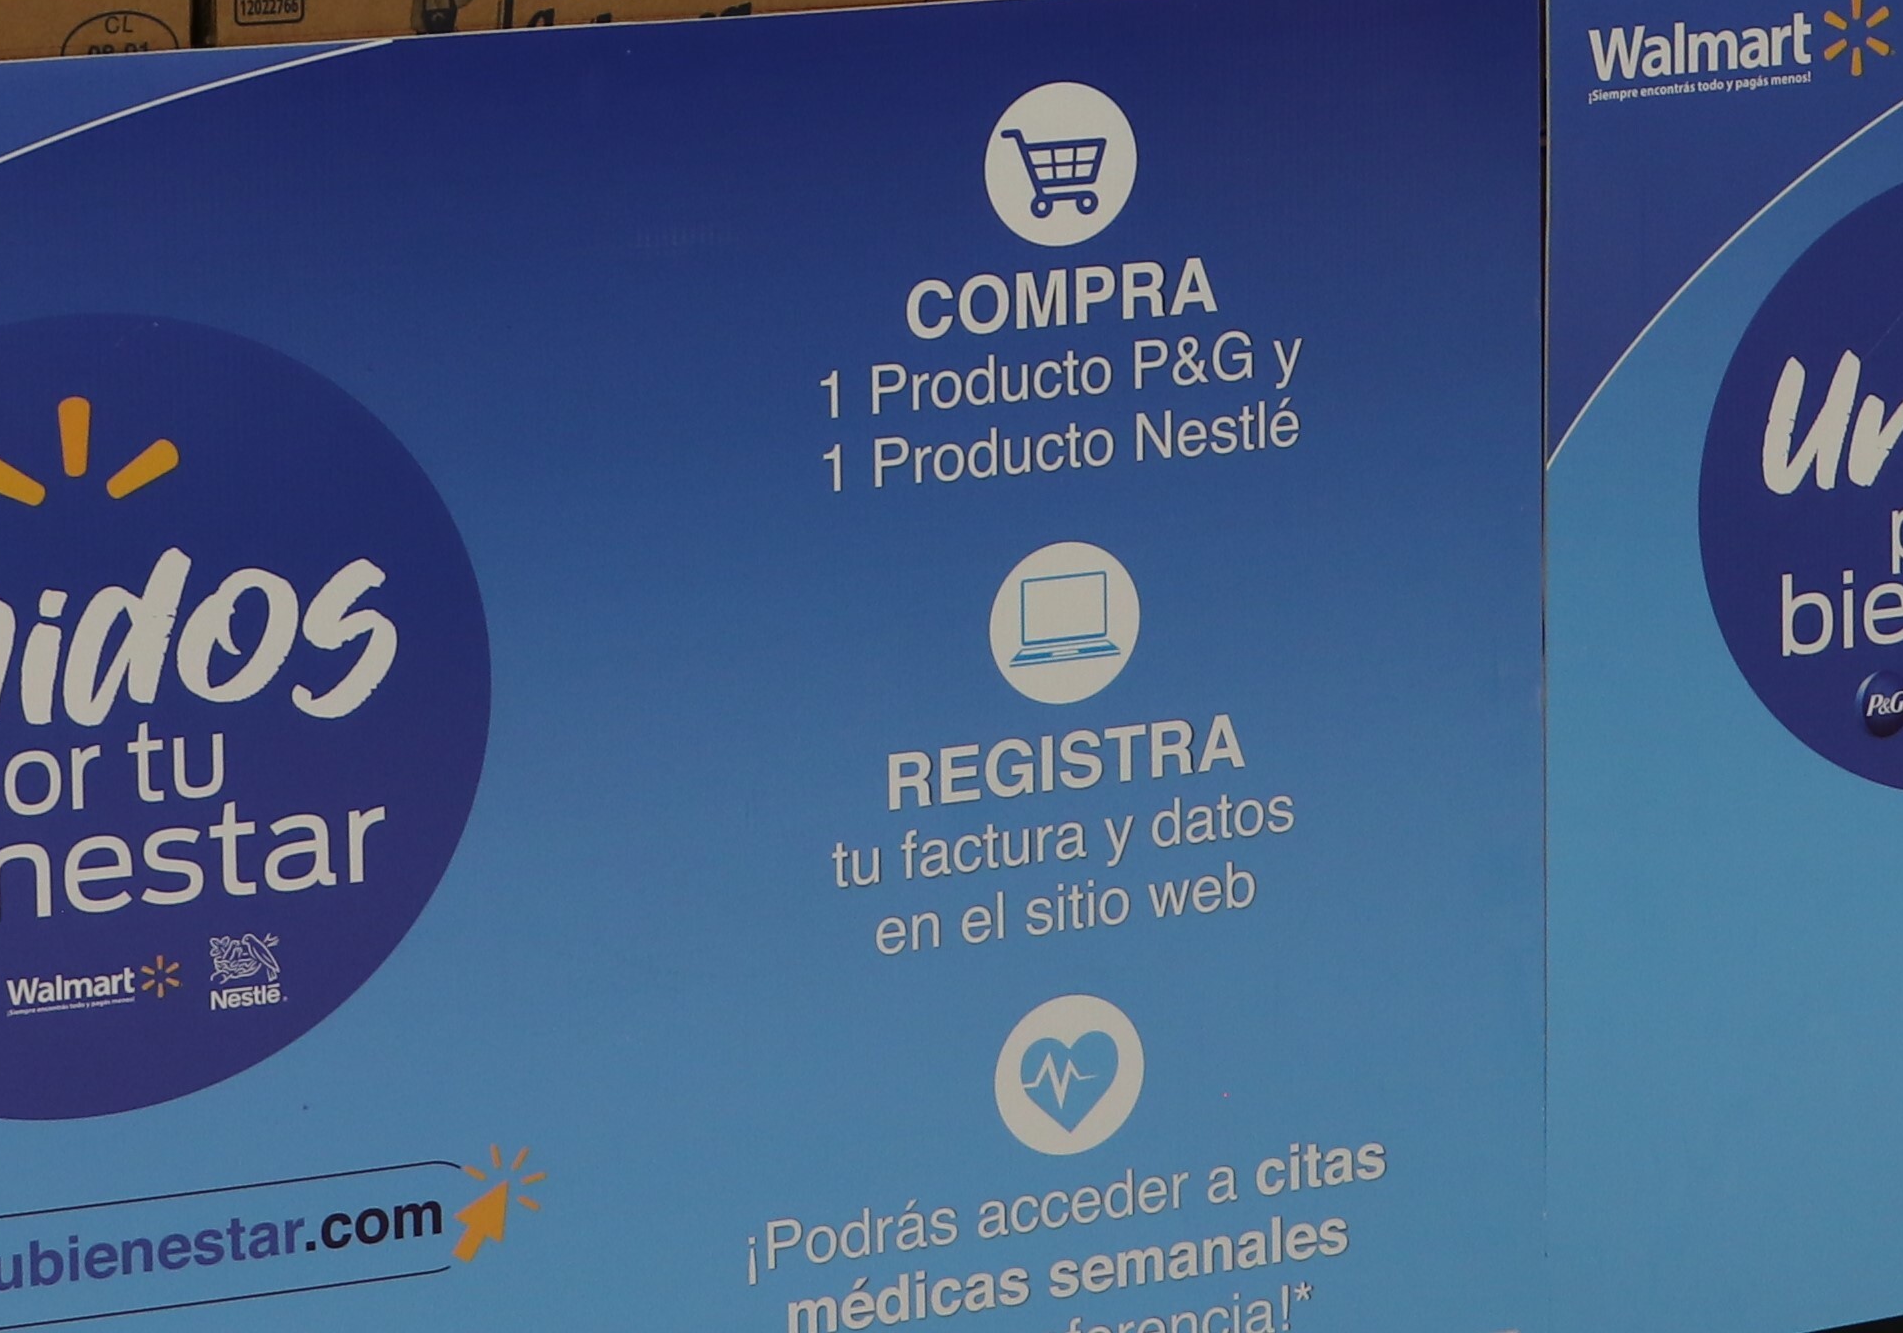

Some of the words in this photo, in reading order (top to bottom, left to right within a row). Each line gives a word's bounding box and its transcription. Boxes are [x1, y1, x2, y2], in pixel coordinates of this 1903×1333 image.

[1589, 12, 1811, 82] Walmart
[904, 257, 1219, 340] COMPRA
[819, 370, 842, 420] 1
[870, 354, 1113, 417] Producto
[1133, 330, 1255, 391] P&G
[1274, 333, 1303, 389] y
[822, 443, 843, 492] 1
[872, 427, 1115, 489] Producto
[1135, 397, 1301, 463] Nestlé
[126, 721, 227, 805] tu
[887, 713, 1245, 813] REGISTRA
[832, 839, 882, 888] tu
[901, 814, 1087, 880] factura
[1104, 817, 1133, 867] y
[1151, 792, 1296, 847] datos
[876, 908, 941, 956] en
[960, 892, 1005, 946] el
[1025, 878, 1131, 938] sitio
[1149, 862, 1257, 919] web
[7, 967, 135, 1006] Walmart
[211, 983, 281, 1011] Nestlé
[747, 1197, 958, 1285] ¡Podrás
[977, 1168, 1189, 1240] acceder
[1207, 1164, 1237, 1204] a
[1255, 1141, 1387, 1197] citas
[788, 1264, 1030, 1333] médicas
[1048, 1215, 1349, 1299] semanales
